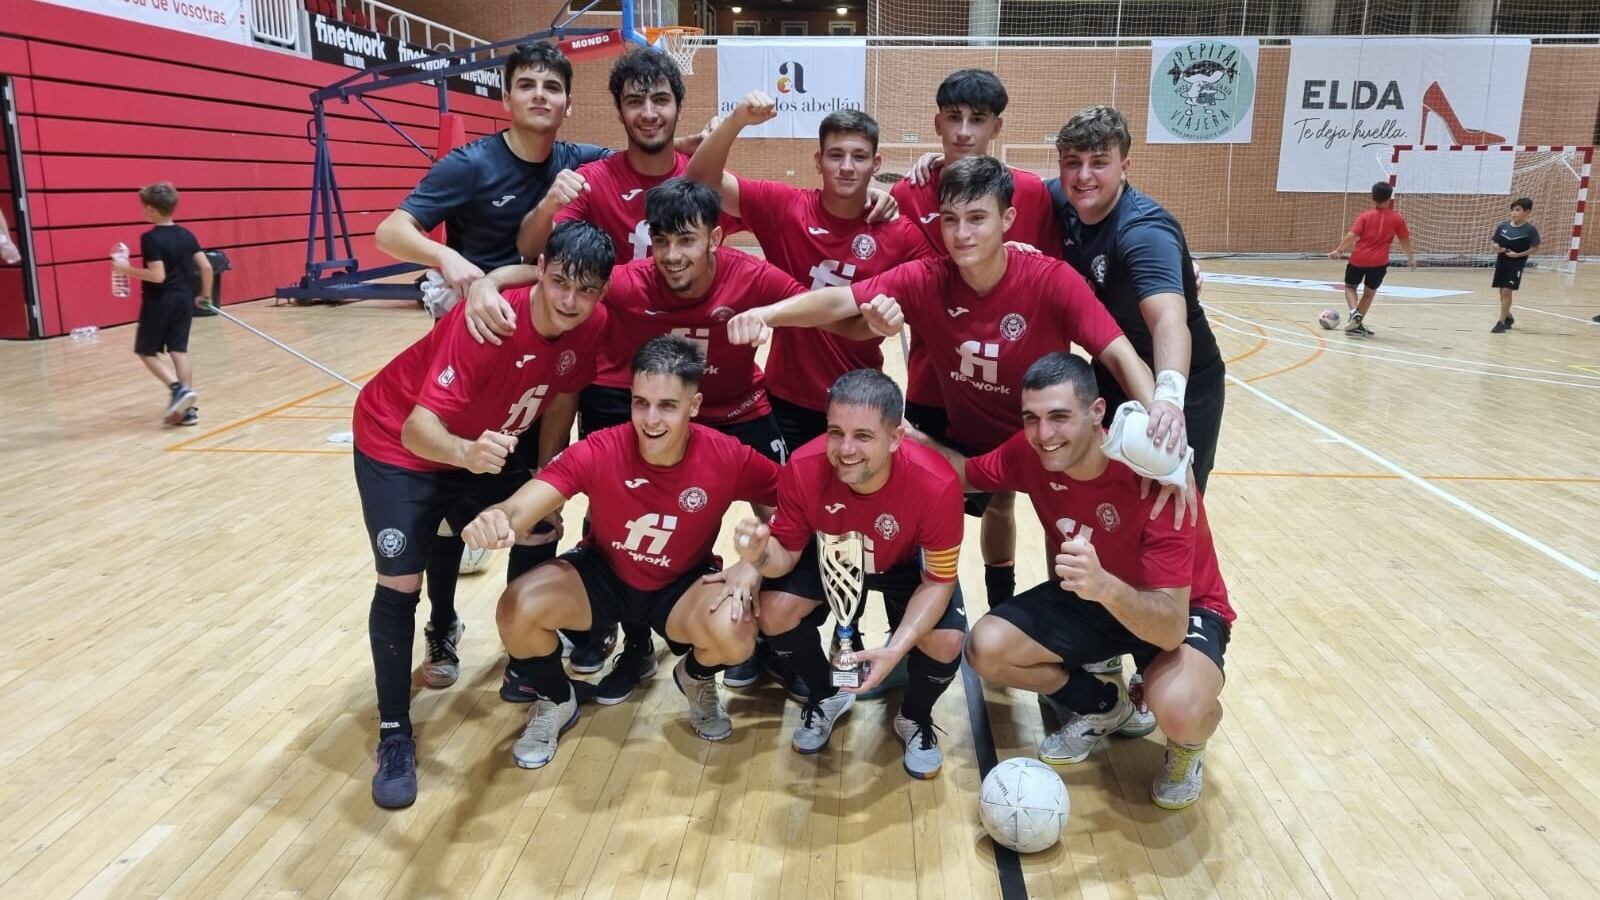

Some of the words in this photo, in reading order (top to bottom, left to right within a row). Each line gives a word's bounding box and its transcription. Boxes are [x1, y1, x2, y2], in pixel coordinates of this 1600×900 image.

[173, 1, 226, 25] vosotras
[315, 14, 387, 60] finetwork
[572, 34, 609, 49] MONDO
[1175, 43, 1236, 67] PEPITA
[802, 97, 861, 112] abellán
[1302, 80, 1404, 110] ELDA
[1170, 110, 1231, 131] VIAJERA
[1294, 117, 1316, 144] Te
[1315, 119, 1350, 149] deja
[950, 371, 1010, 394] nework
[624, 513, 678, 555] fi
